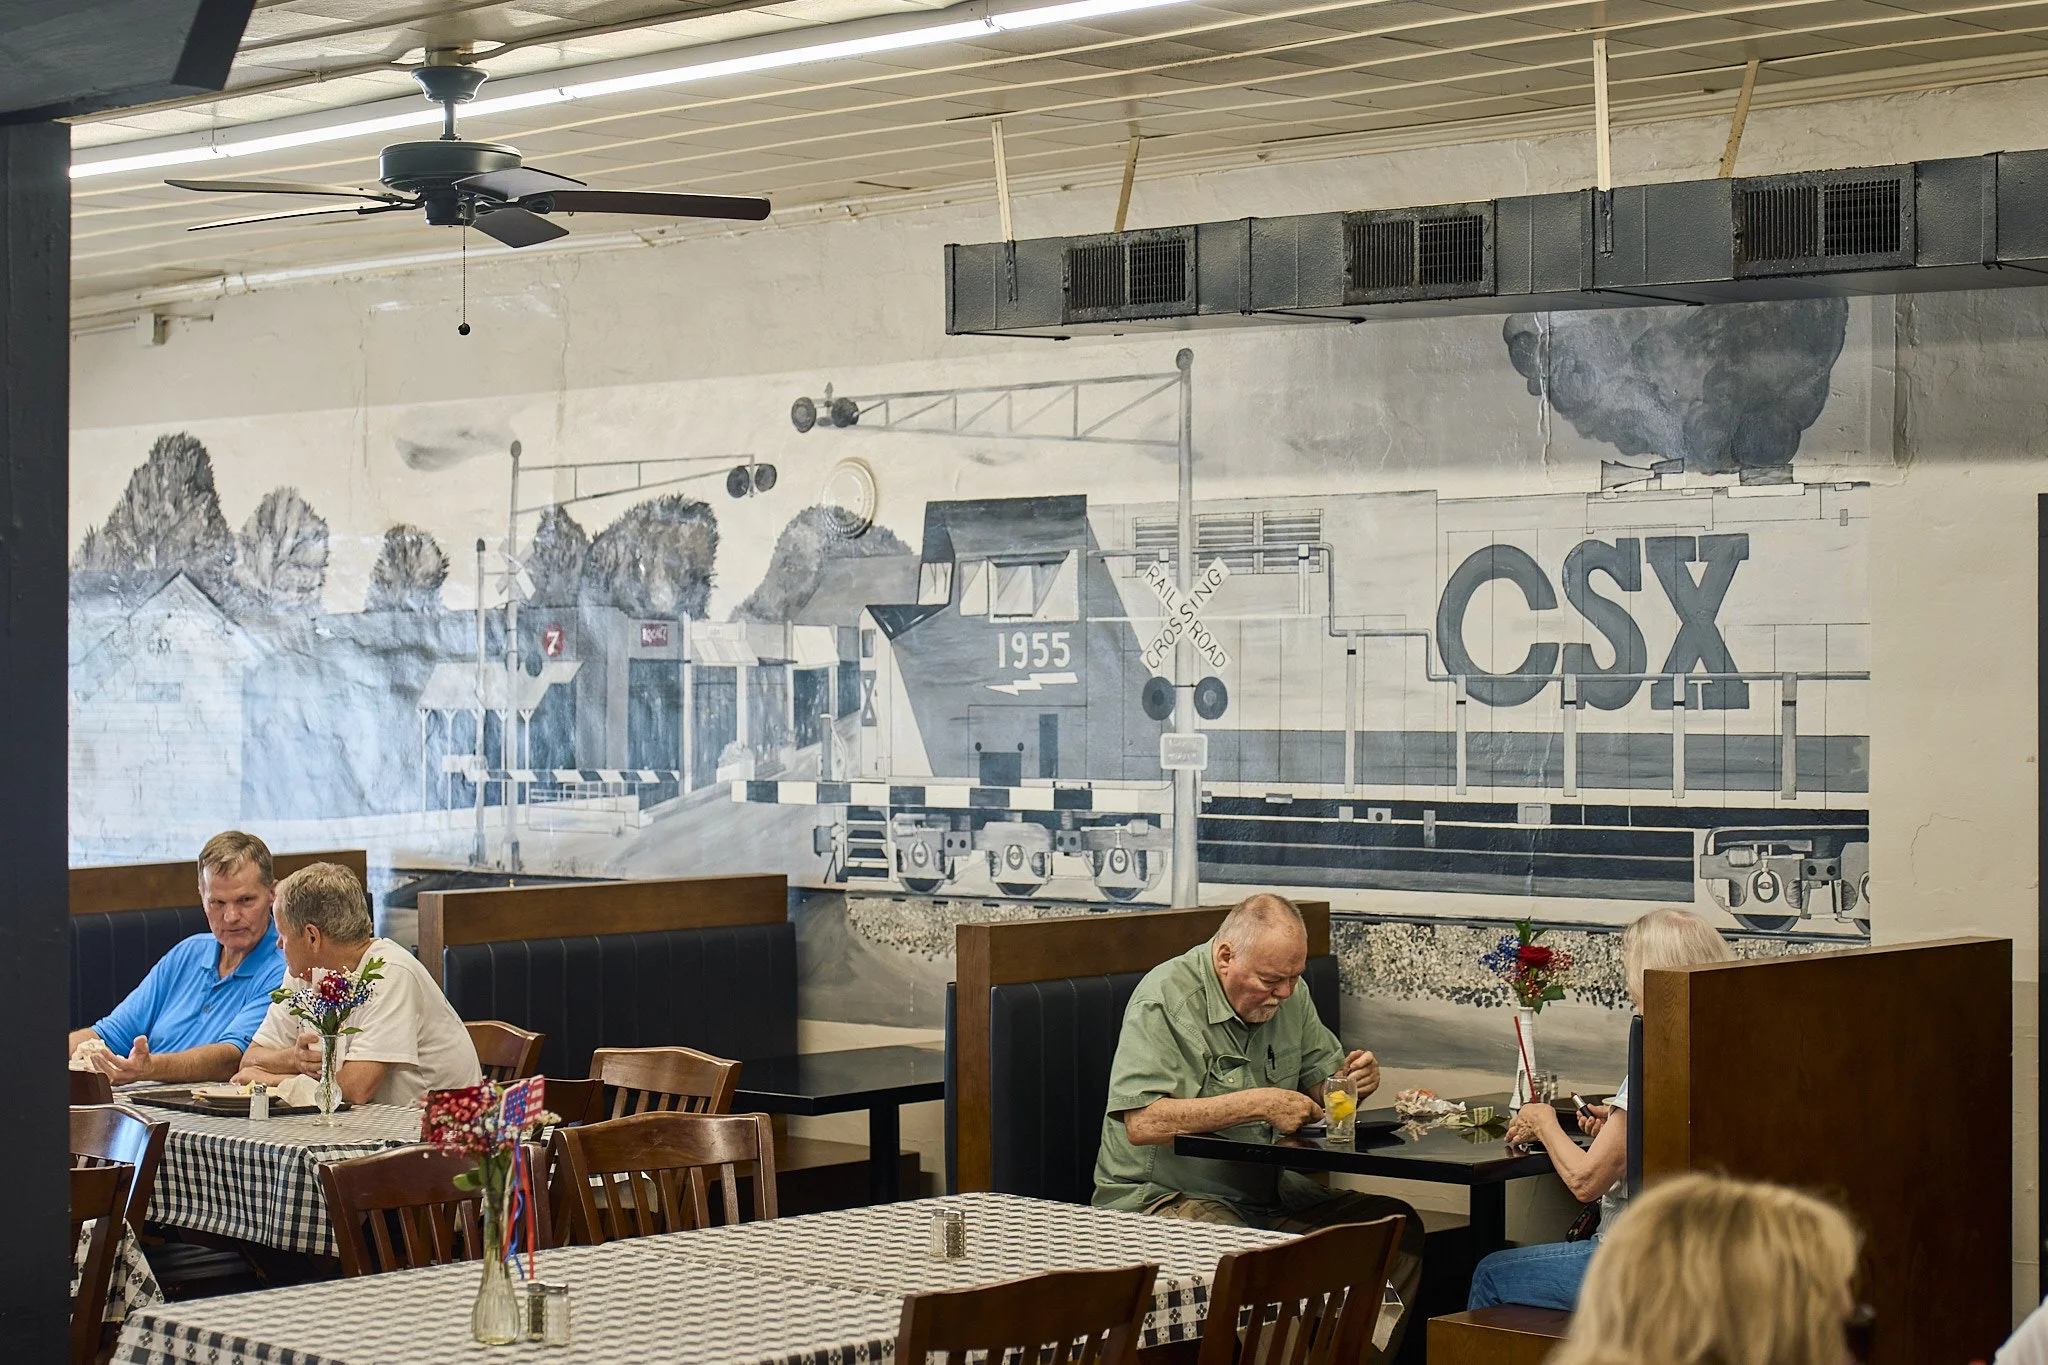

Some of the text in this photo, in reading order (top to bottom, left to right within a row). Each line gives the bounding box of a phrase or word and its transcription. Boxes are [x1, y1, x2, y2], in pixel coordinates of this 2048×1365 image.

[546, 630, 560, 656] 7
[998, 631, 1071, 669] 1955
[1146, 565, 1226, 669] RAIL ROAD
[1146, 568, 1223, 669] CROSSING
[1436, 533, 1749, 711] CSX
